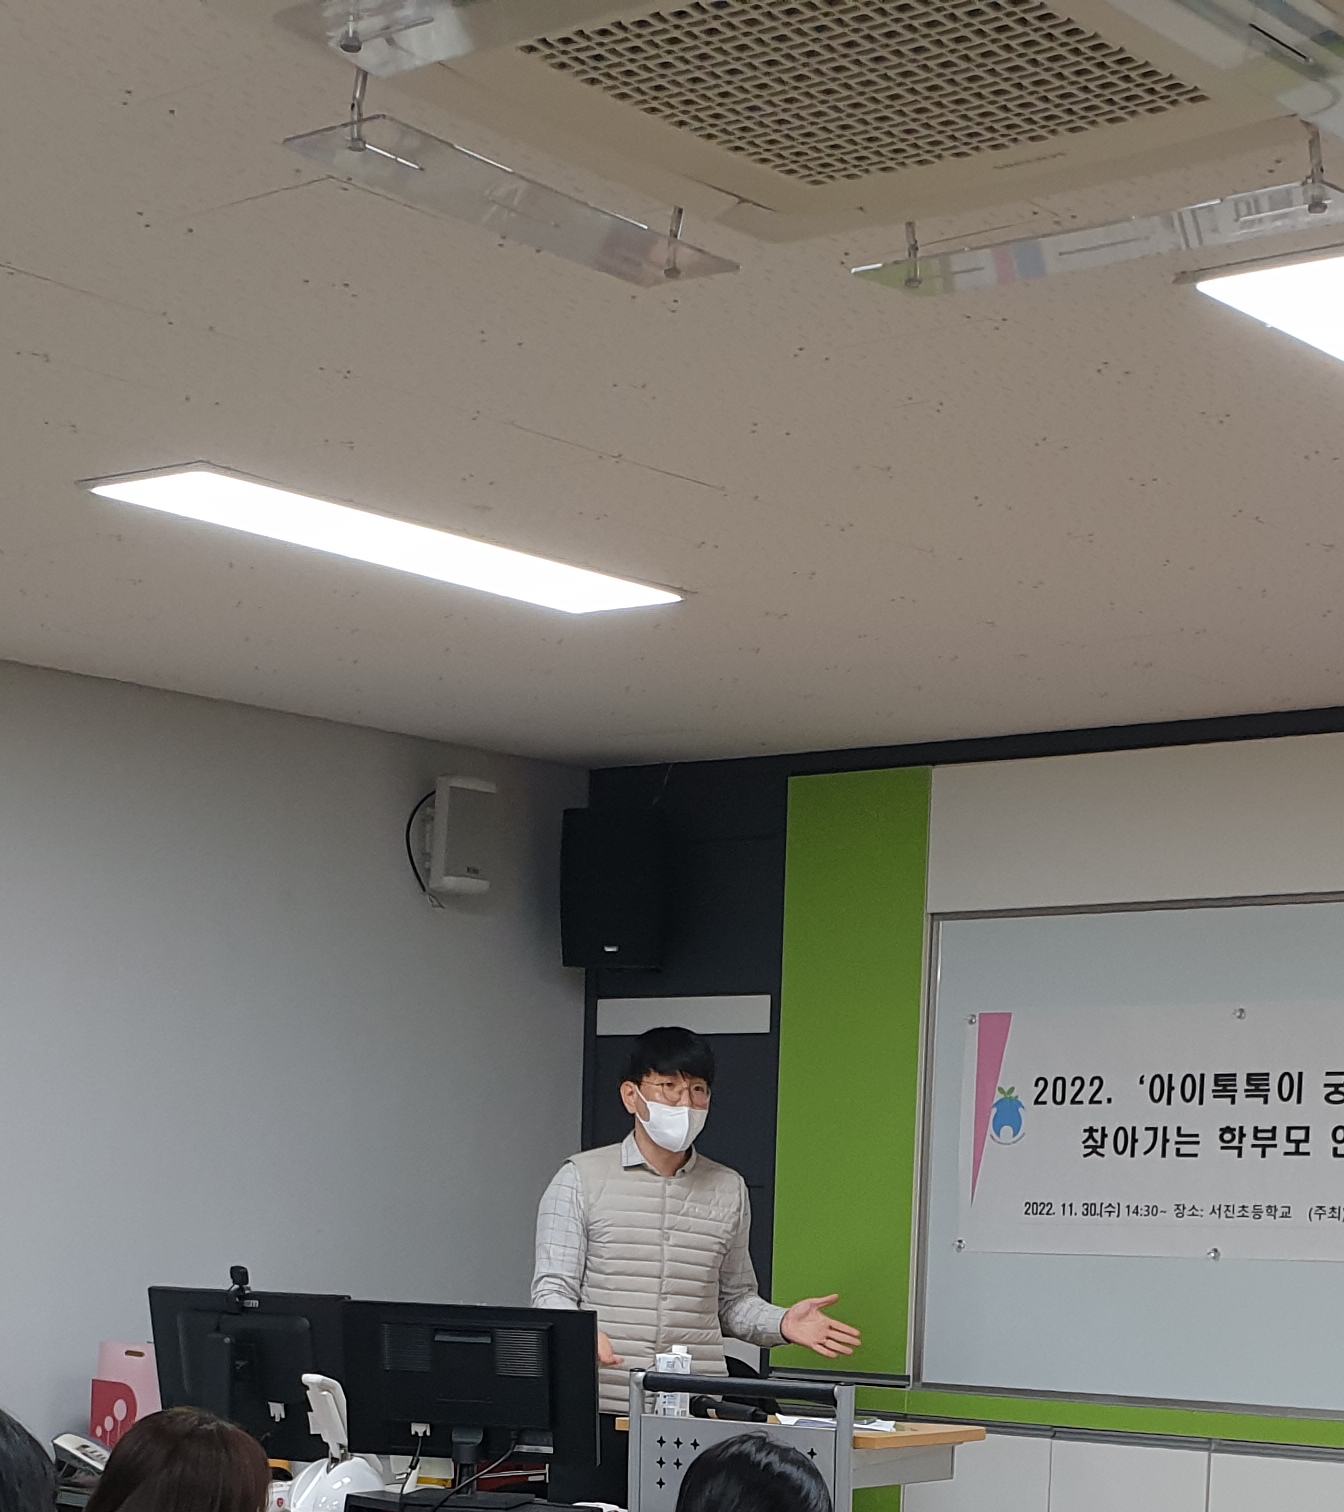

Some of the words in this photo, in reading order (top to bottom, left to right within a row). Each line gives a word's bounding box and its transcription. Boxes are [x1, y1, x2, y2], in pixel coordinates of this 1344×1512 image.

[1033, 1076, 1112, 1105] 2022.
[1081, 1125, 1201, 1159] 찾아가는
[1218, 1125, 1311, 1159] 학부모
[1024, 1201, 1056, 1216] 2022.
[1061, 1202, 1078, 1217] 11.
[1209, 1203, 1292, 1220] 서진초등학교
